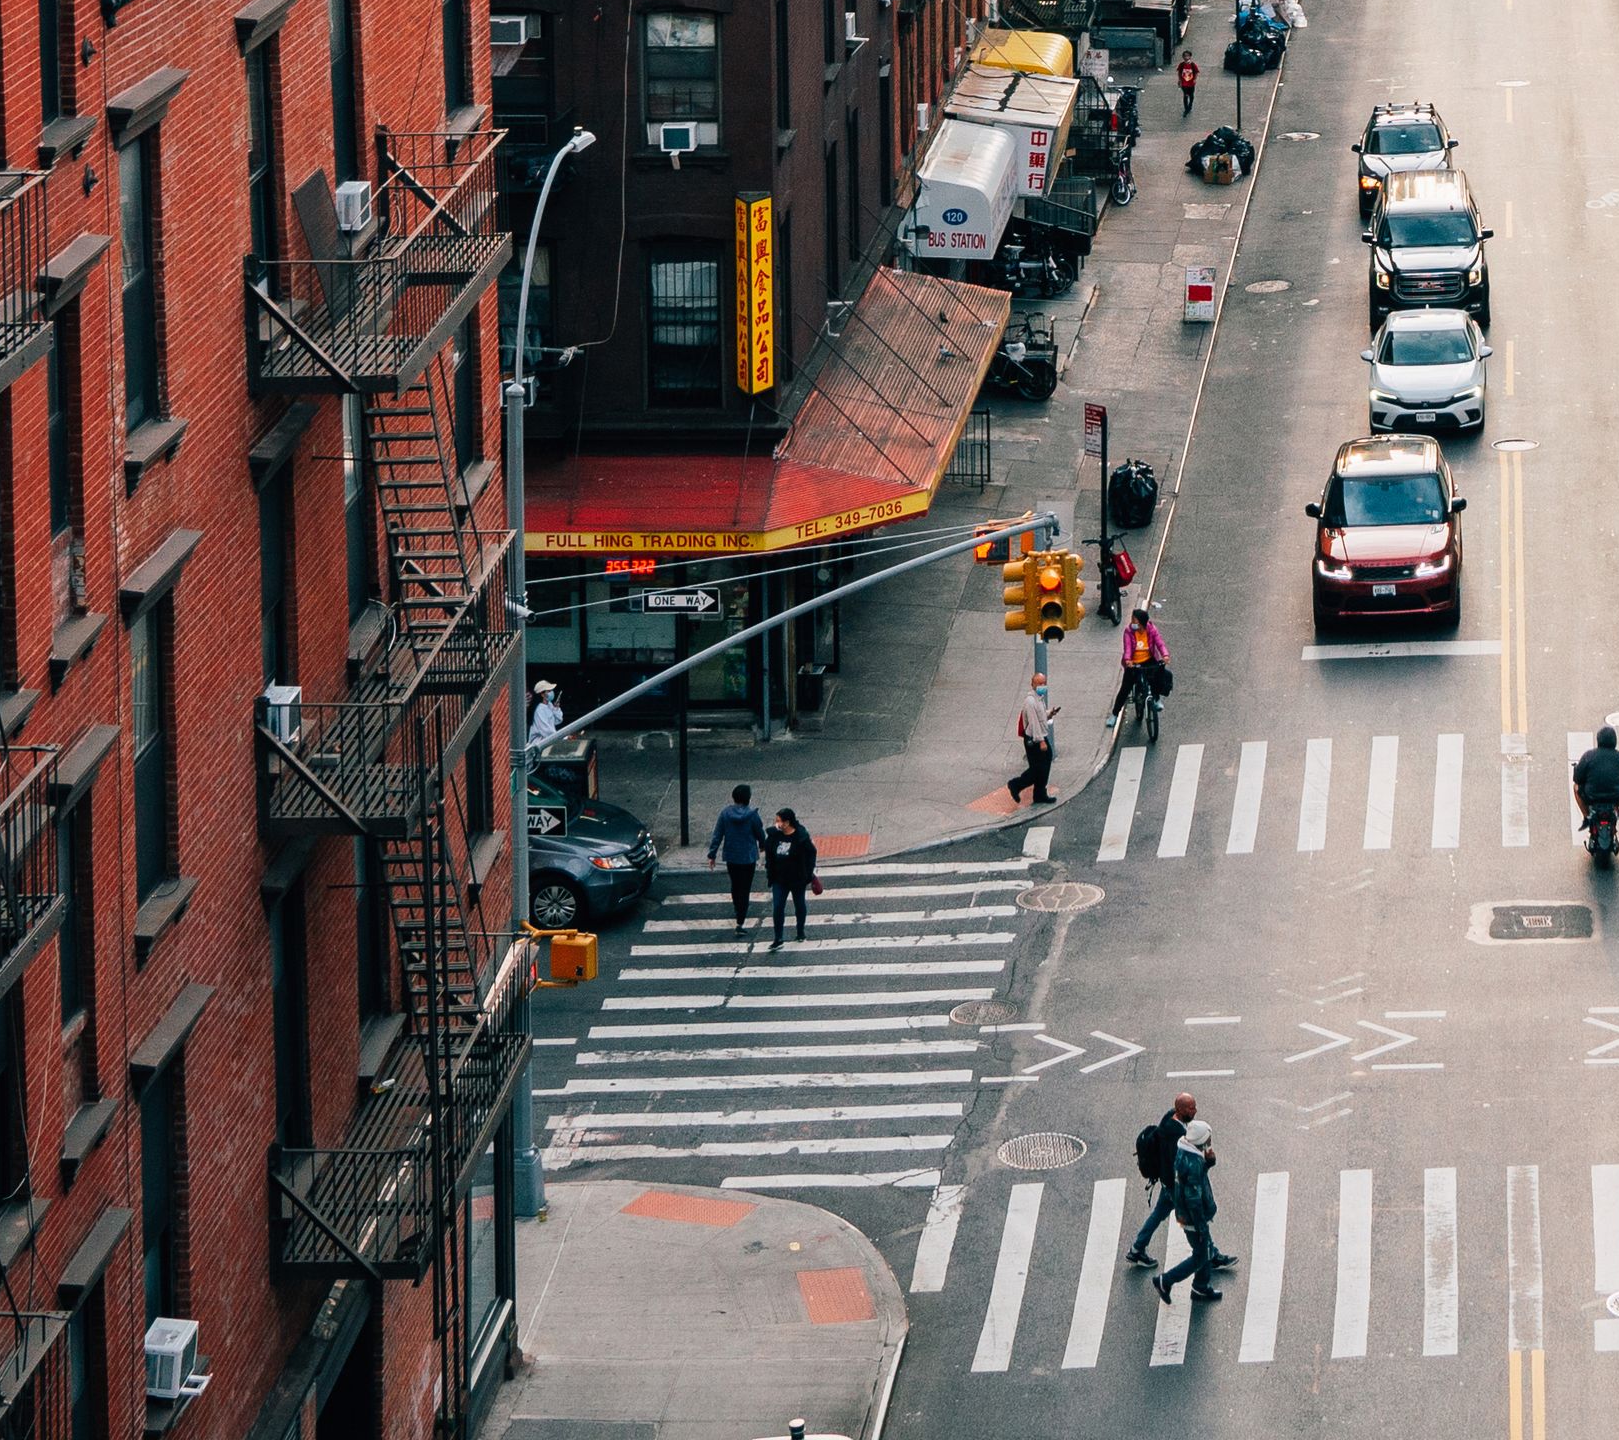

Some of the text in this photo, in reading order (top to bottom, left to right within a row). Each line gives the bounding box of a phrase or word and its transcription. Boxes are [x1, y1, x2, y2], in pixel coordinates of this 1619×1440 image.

[1027, 130, 1048, 190] 中藥行
[944, 211, 963, 223] 120
[928, 231, 986, 249] BUS STATION
[795, 501, 903, 539] TEL: 349-7036
[545, 534, 755, 549] FULL HING TRADING INC.
[653, 595, 708, 607] ONE WAY
